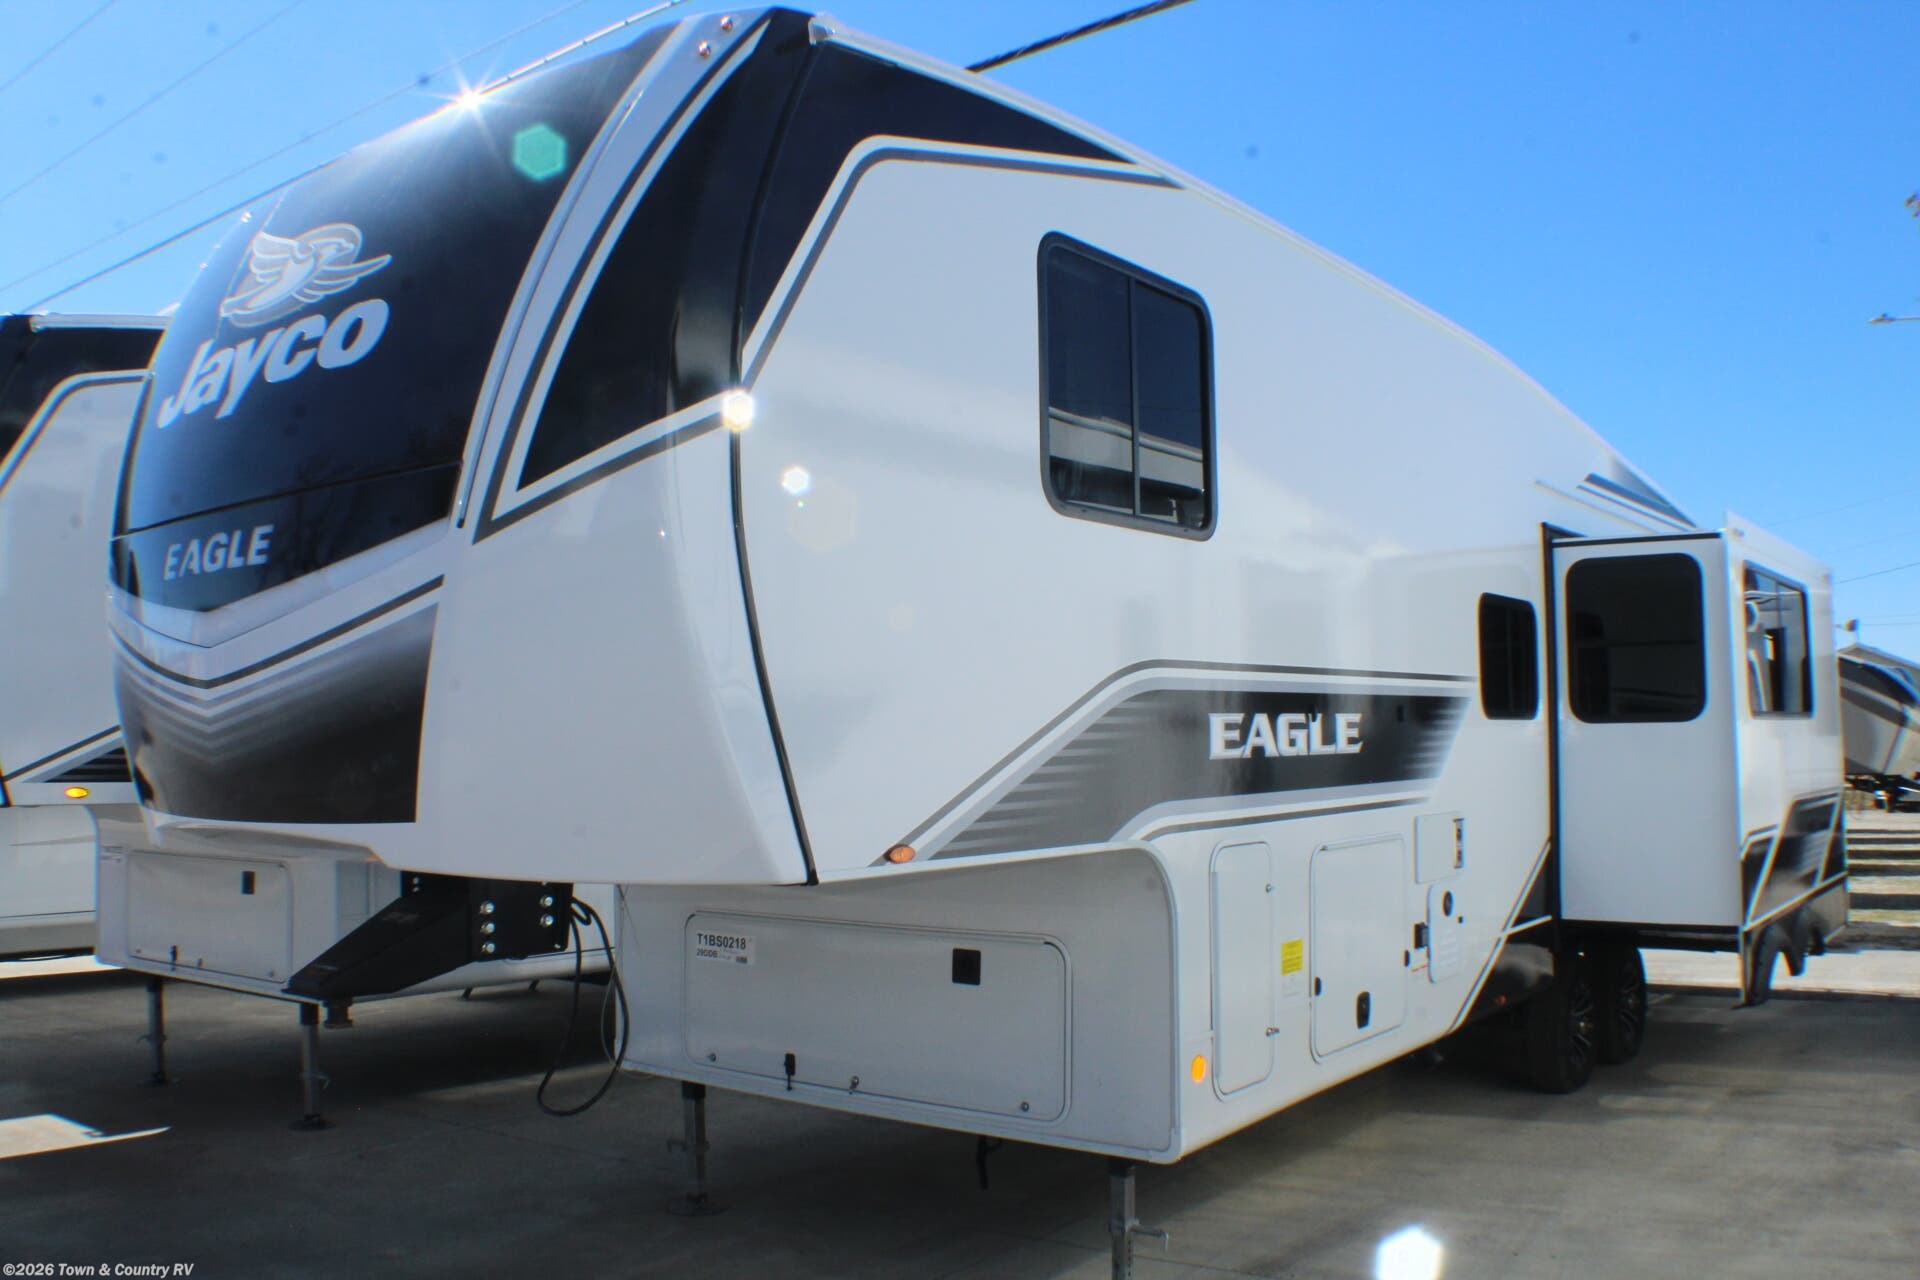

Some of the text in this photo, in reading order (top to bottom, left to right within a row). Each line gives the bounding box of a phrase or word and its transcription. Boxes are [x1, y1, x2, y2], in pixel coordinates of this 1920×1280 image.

[157, 299, 390, 429] Jayco
[163, 525, 274, 581] EAGLE
[1208, 713, 1363, 760] EAGLE
[696, 933, 746, 950] T1BS0218
